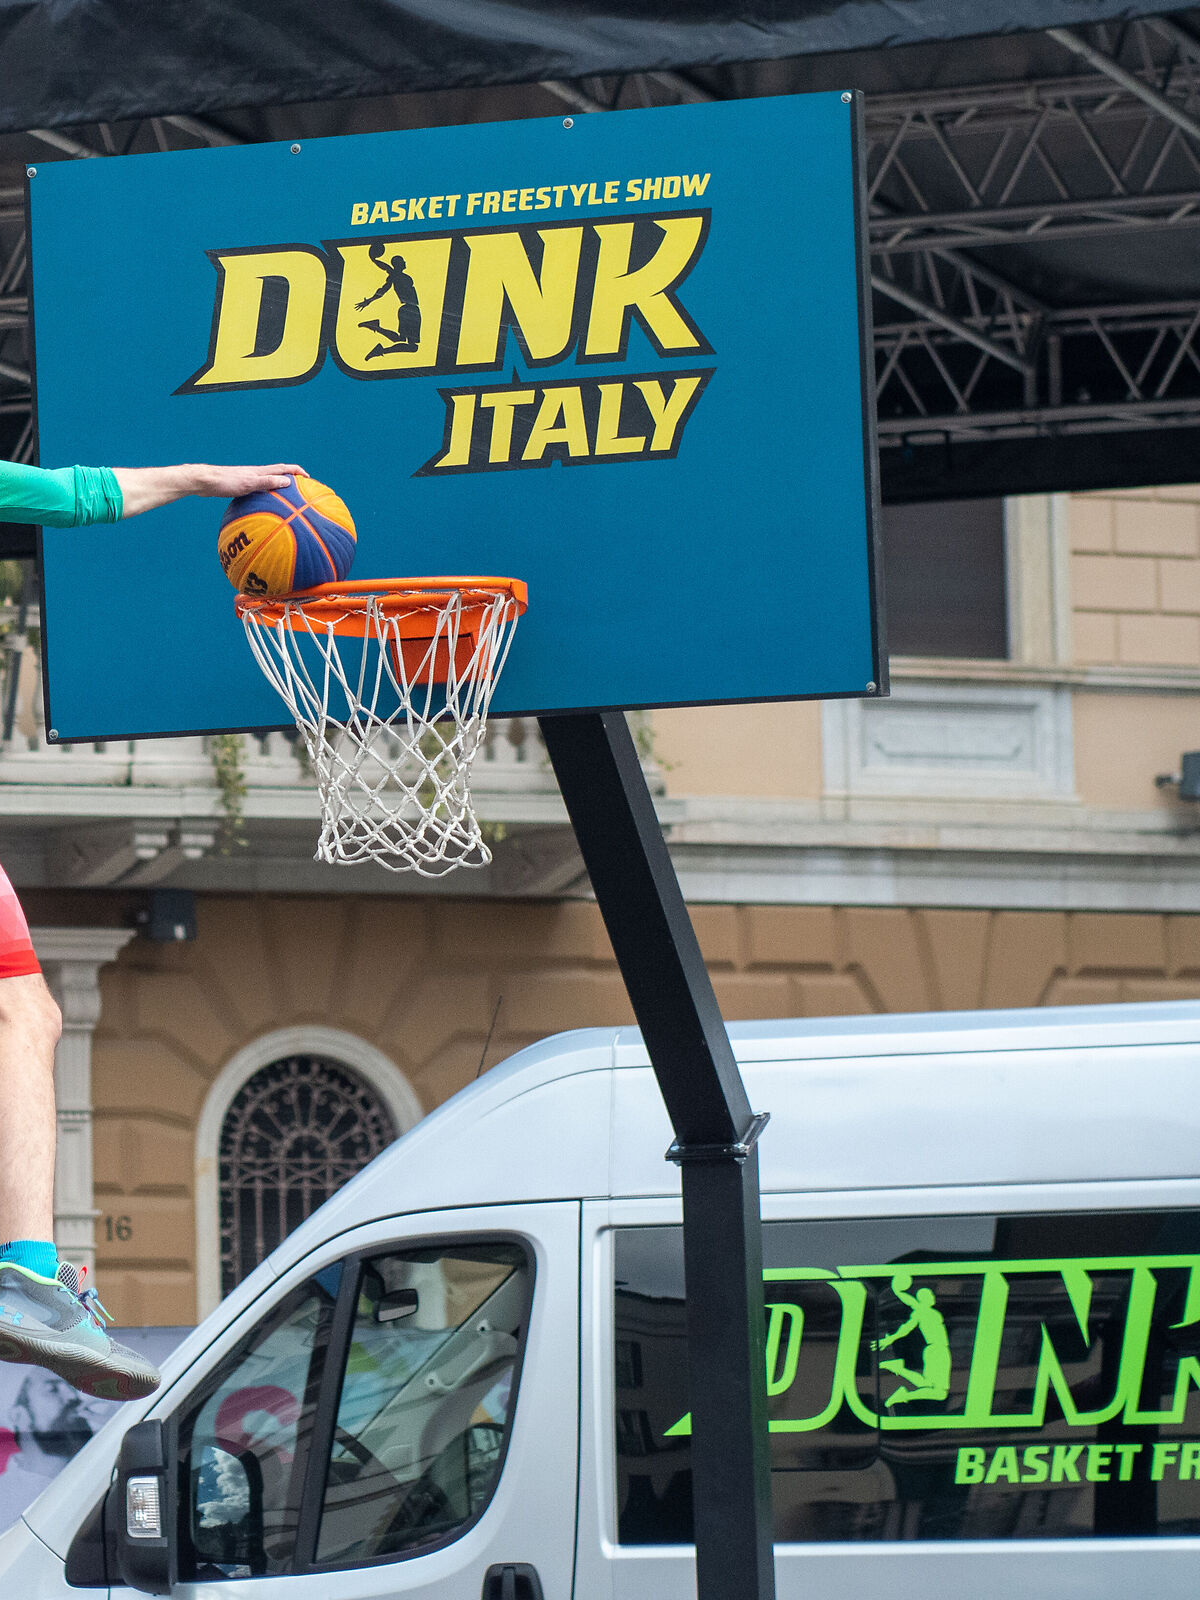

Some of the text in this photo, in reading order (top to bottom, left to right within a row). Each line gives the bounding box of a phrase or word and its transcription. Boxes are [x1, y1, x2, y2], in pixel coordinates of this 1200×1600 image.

[351, 173, 711, 226] BASKET FREESTYLE SHOW
[193, 215, 703, 387] DUNK
[433, 376, 701, 468] ITALY
[105, 1215, 133, 1242] 16
[954, 1443, 1144, 1485] BASKET
